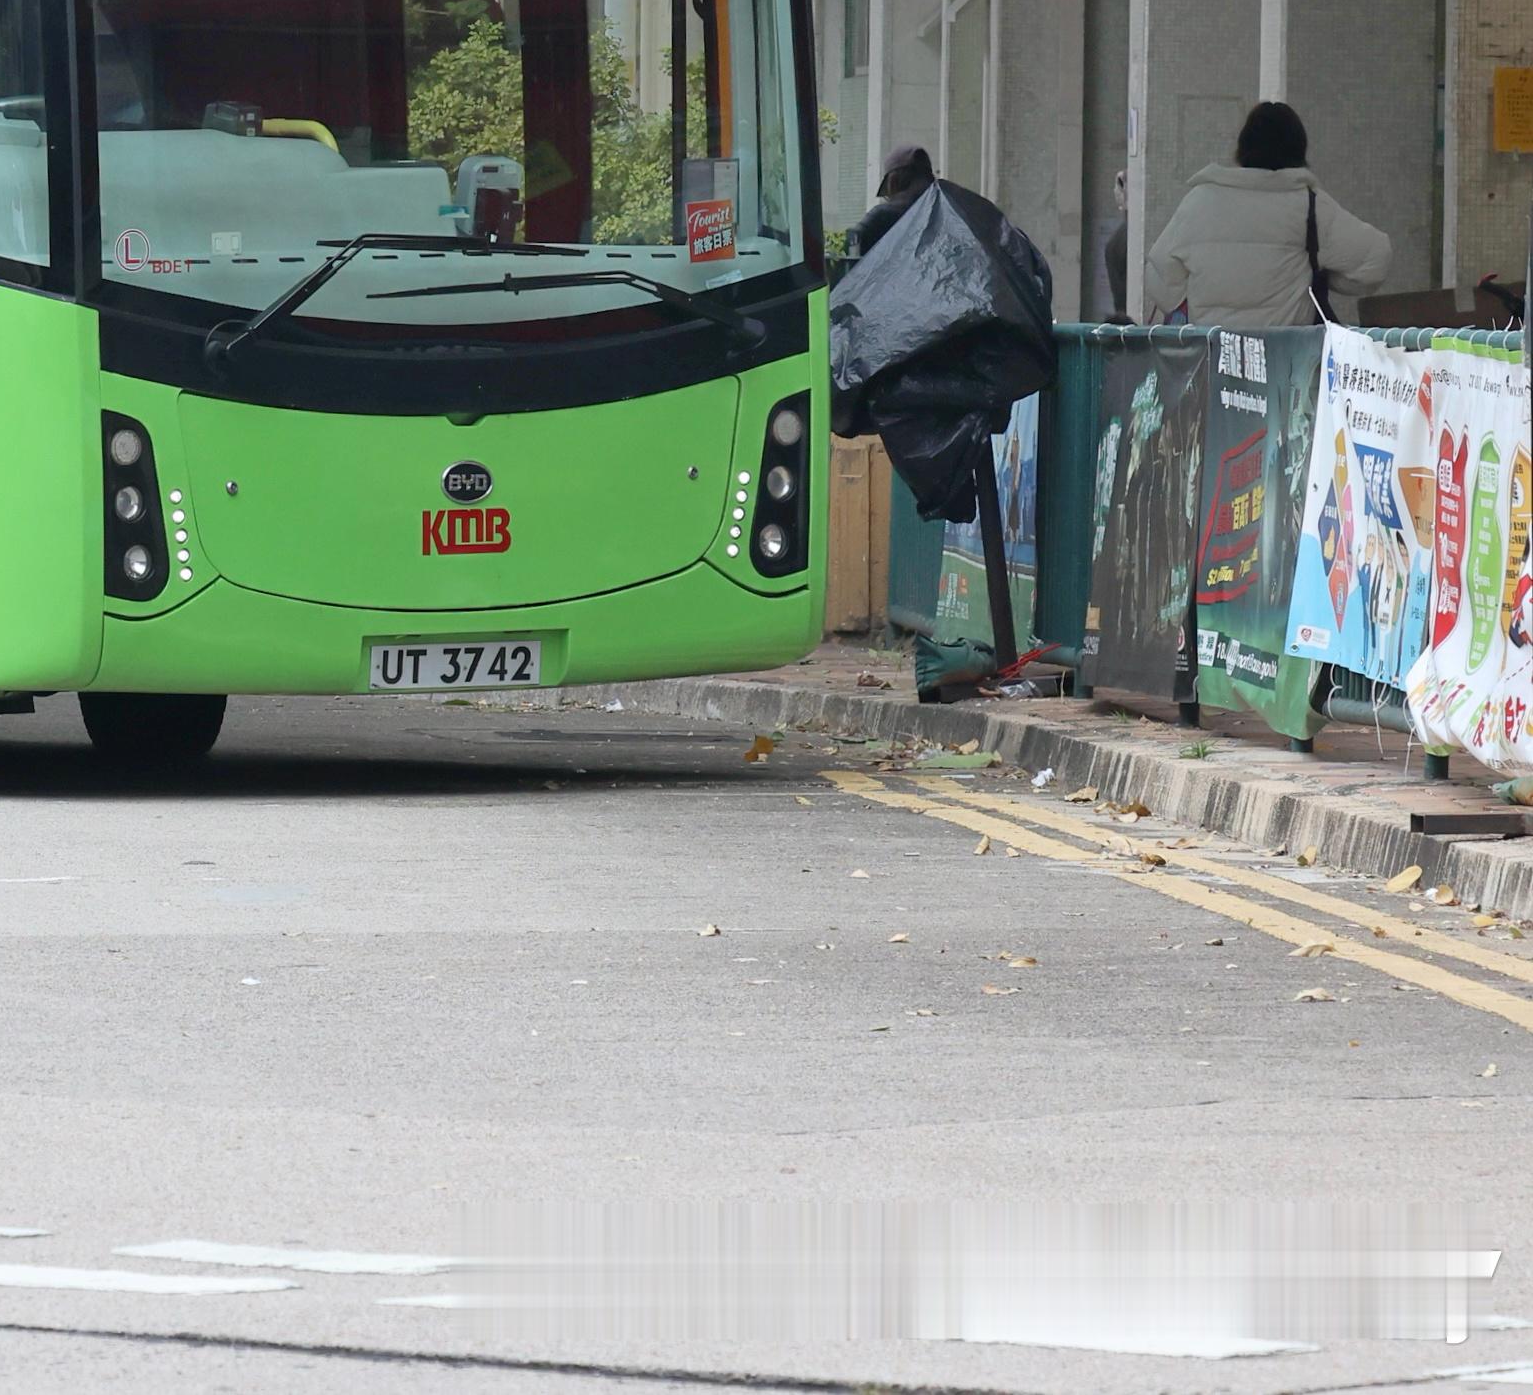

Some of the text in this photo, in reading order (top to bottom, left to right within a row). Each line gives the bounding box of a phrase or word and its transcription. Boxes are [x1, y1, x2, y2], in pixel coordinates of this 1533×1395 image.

[688, 207, 730, 233] Tourist
[124, 237, 141, 264] L
[694, 229, 733, 255] 旅客日票
[448, 473, 488, 491] BYD
[422, 508, 511, 556] KMB
[382, 646, 532, 685] UT 3742
